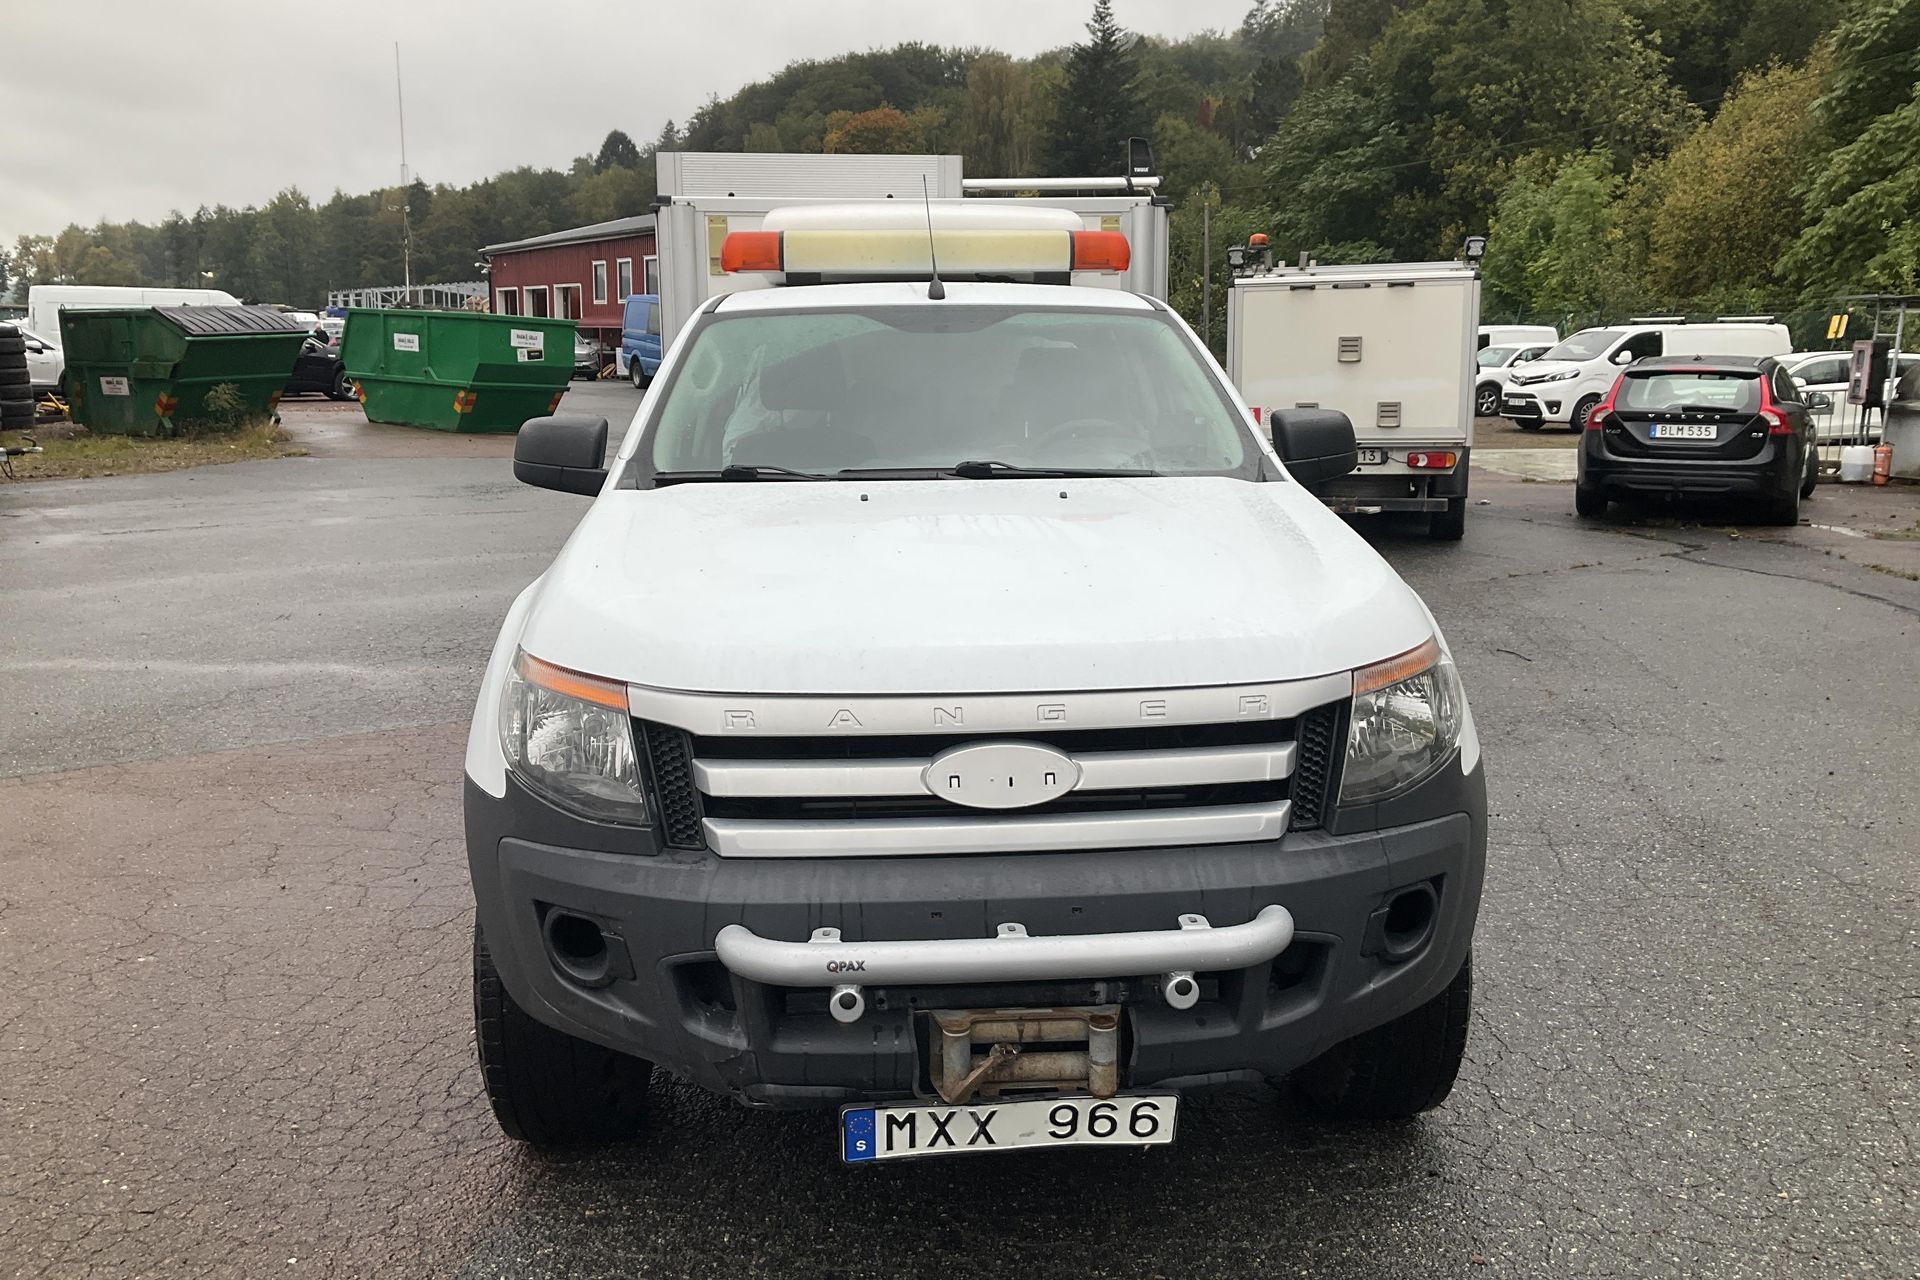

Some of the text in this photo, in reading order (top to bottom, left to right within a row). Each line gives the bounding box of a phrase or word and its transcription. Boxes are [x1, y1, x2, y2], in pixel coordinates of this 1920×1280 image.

[1660, 425, 1711, 437] BLM 535
[722, 693, 1269, 729] RANGER
[826, 959, 866, 974] QPAX
[885, 1100, 1161, 1152] MXX 966
[855, 1139, 867, 1152] S
